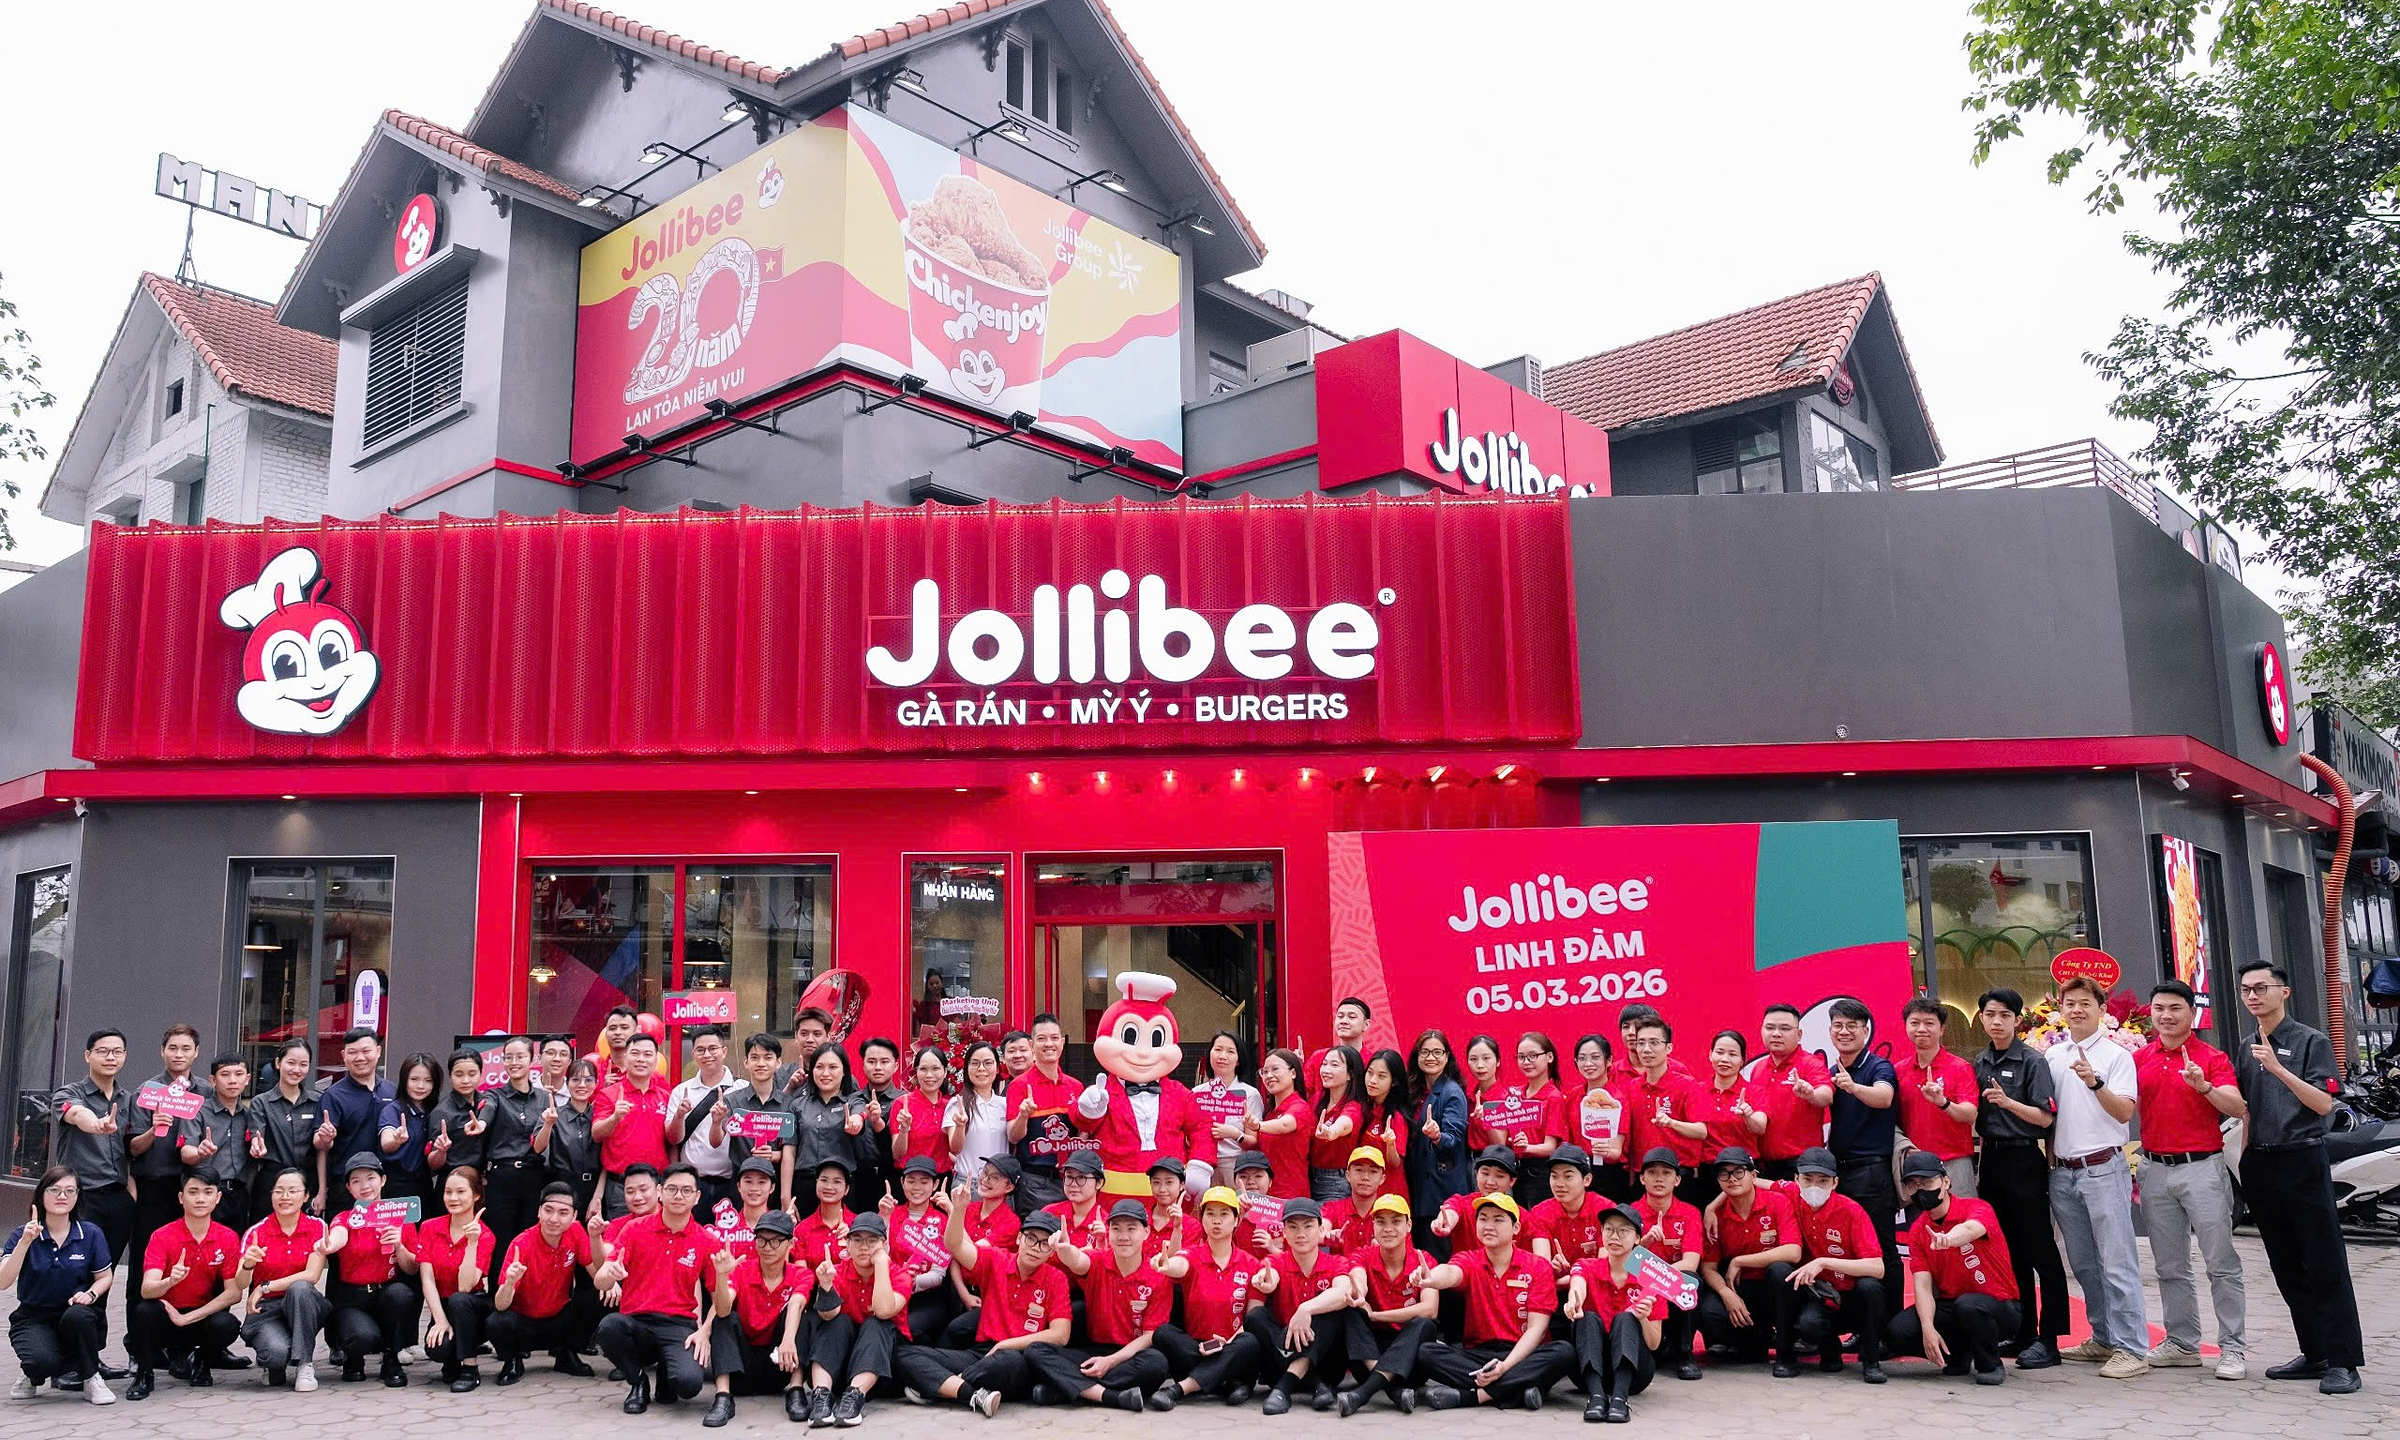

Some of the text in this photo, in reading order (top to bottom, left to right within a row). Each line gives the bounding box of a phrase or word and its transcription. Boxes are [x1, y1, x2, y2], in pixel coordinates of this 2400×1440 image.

[156, 152, 327, 237] MAN
[621, 193, 744, 281] Jollibee
[1043, 219, 1102, 257] Jollibee
[1054, 242, 1103, 279] Group
[906, 249, 1048, 344] Chickenjoy
[694, 323, 742, 368] năm
[626, 367, 745, 432] LAN TỎA NIỀM VUI
[865, 569, 1379, 687] Jollibee
[898, 688, 1348, 727] GÀ RÁN MỲ Ý BURGERS
[923, 881, 994, 901] NHẬN HÀNG
[1447, 874, 1649, 933] Jollibee
[1474, 928, 1645, 973] LINH ĐÀM
[2082, 961, 2092, 969] Ty
[672, 1001, 716, 1018] Jollibee
[942, 998, 997, 1006] Marketing Unit
[1466, 968, 1667, 1015] 05.03.2026
[751, 1114, 782, 1123] Jollibee
[1053, 1139, 1101, 1151] Jollibee
[374, 1201, 408, 1212] Jollibee
[720, 1229, 756, 1242] Jollib
[1642, 1265, 1657, 1279] LINH
[1645, 1256, 1678, 1282] Jollibee
